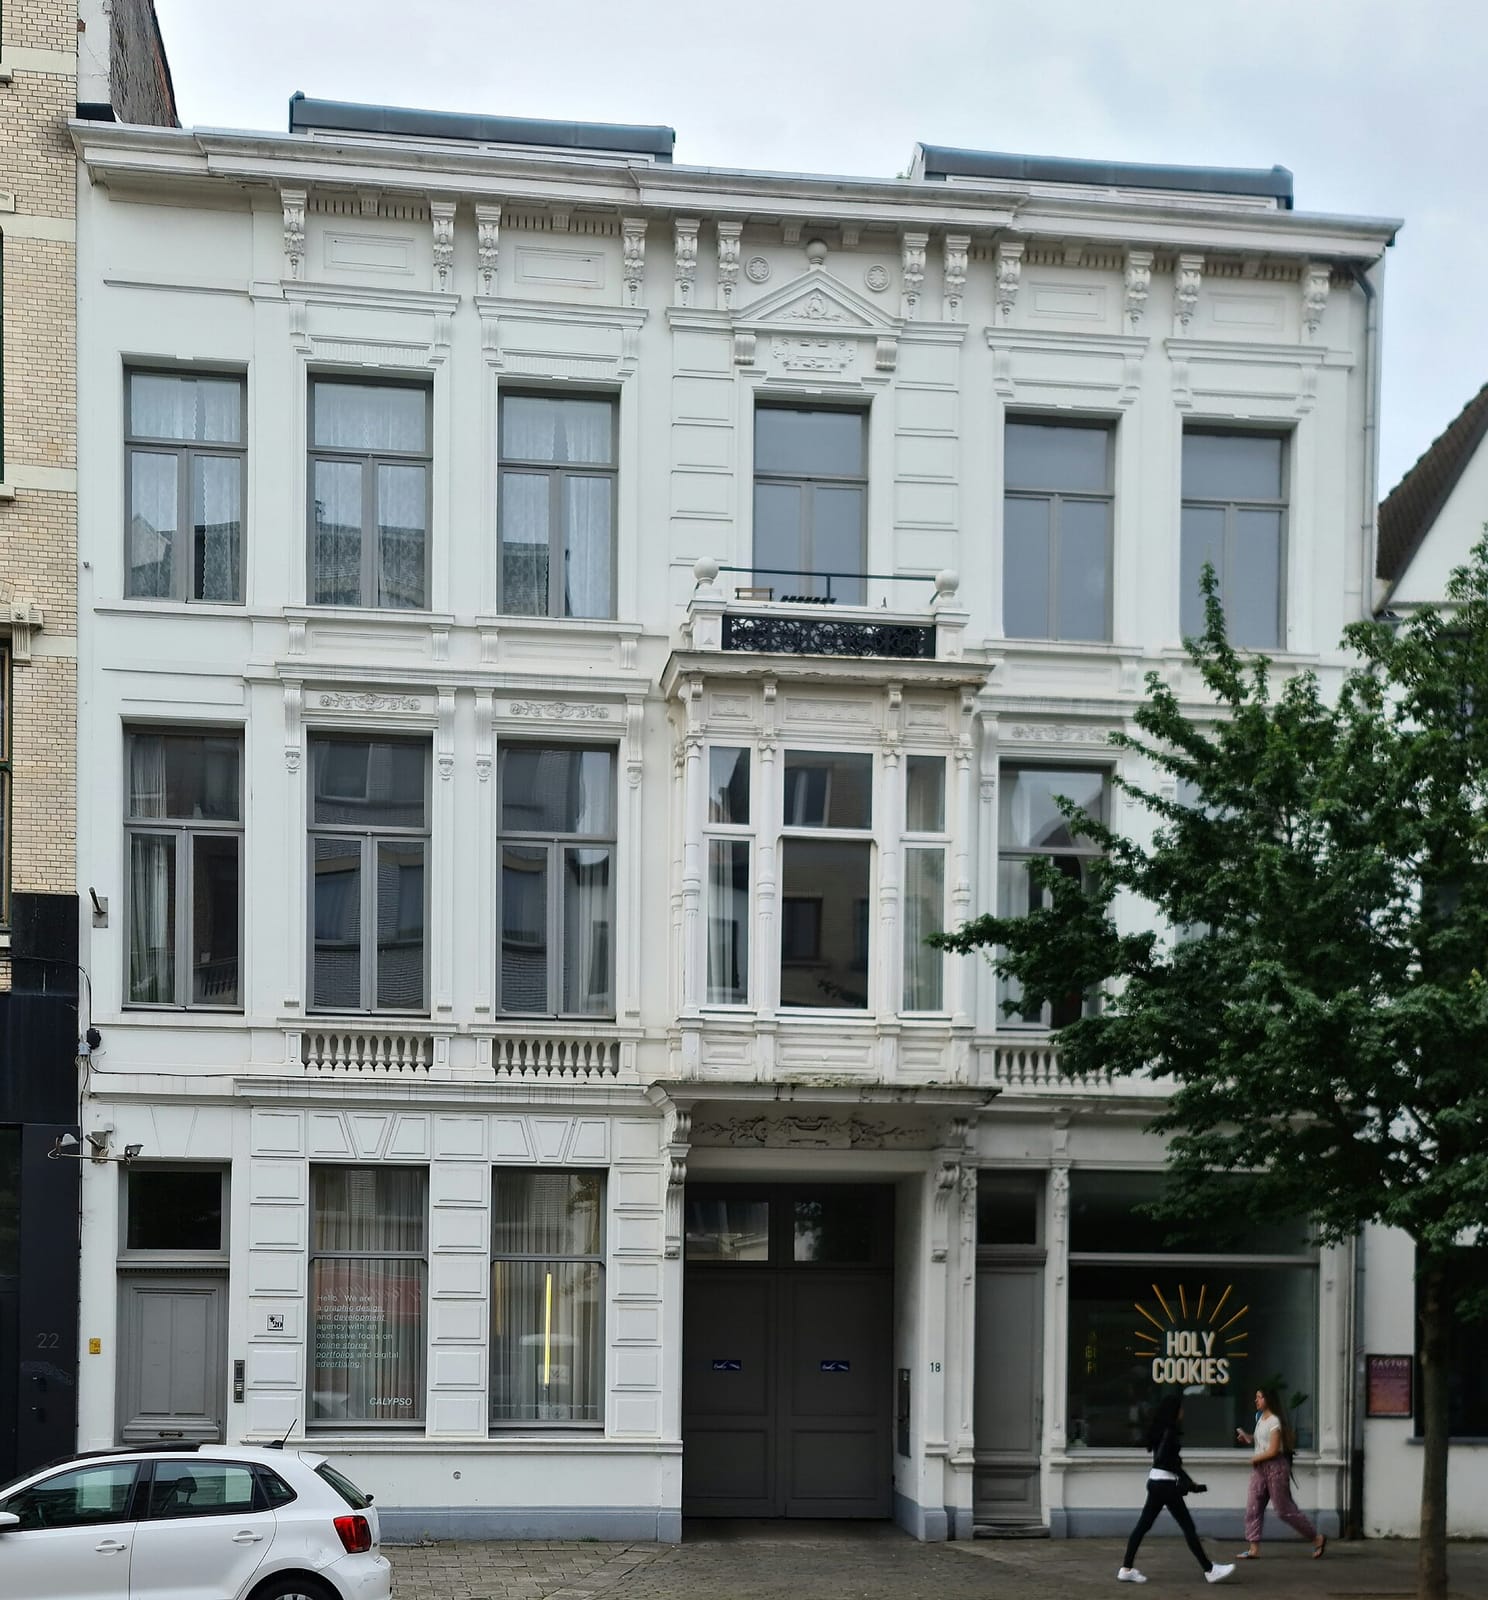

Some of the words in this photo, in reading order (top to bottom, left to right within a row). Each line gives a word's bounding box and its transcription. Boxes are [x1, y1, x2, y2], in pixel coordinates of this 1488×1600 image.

[344, 1294, 357, 1302] We
[325, 1304, 354, 1313] graphic
[316, 1313, 332, 1321] and
[333, 1313, 385, 1322] development
[316, 1323, 346, 1331] agency
[37, 1332, 60, 1349] 22
[1166, 1330, 1216, 1357] HOLY
[316, 1351, 354, 1359] portfolios
[929, 1362, 942, 1373] 18
[1371, 1359, 1409, 1368] CACTUS
[1152, 1357, 1230, 1384] COOKIES
[369, 1397, 413, 1406] CALYPSO
